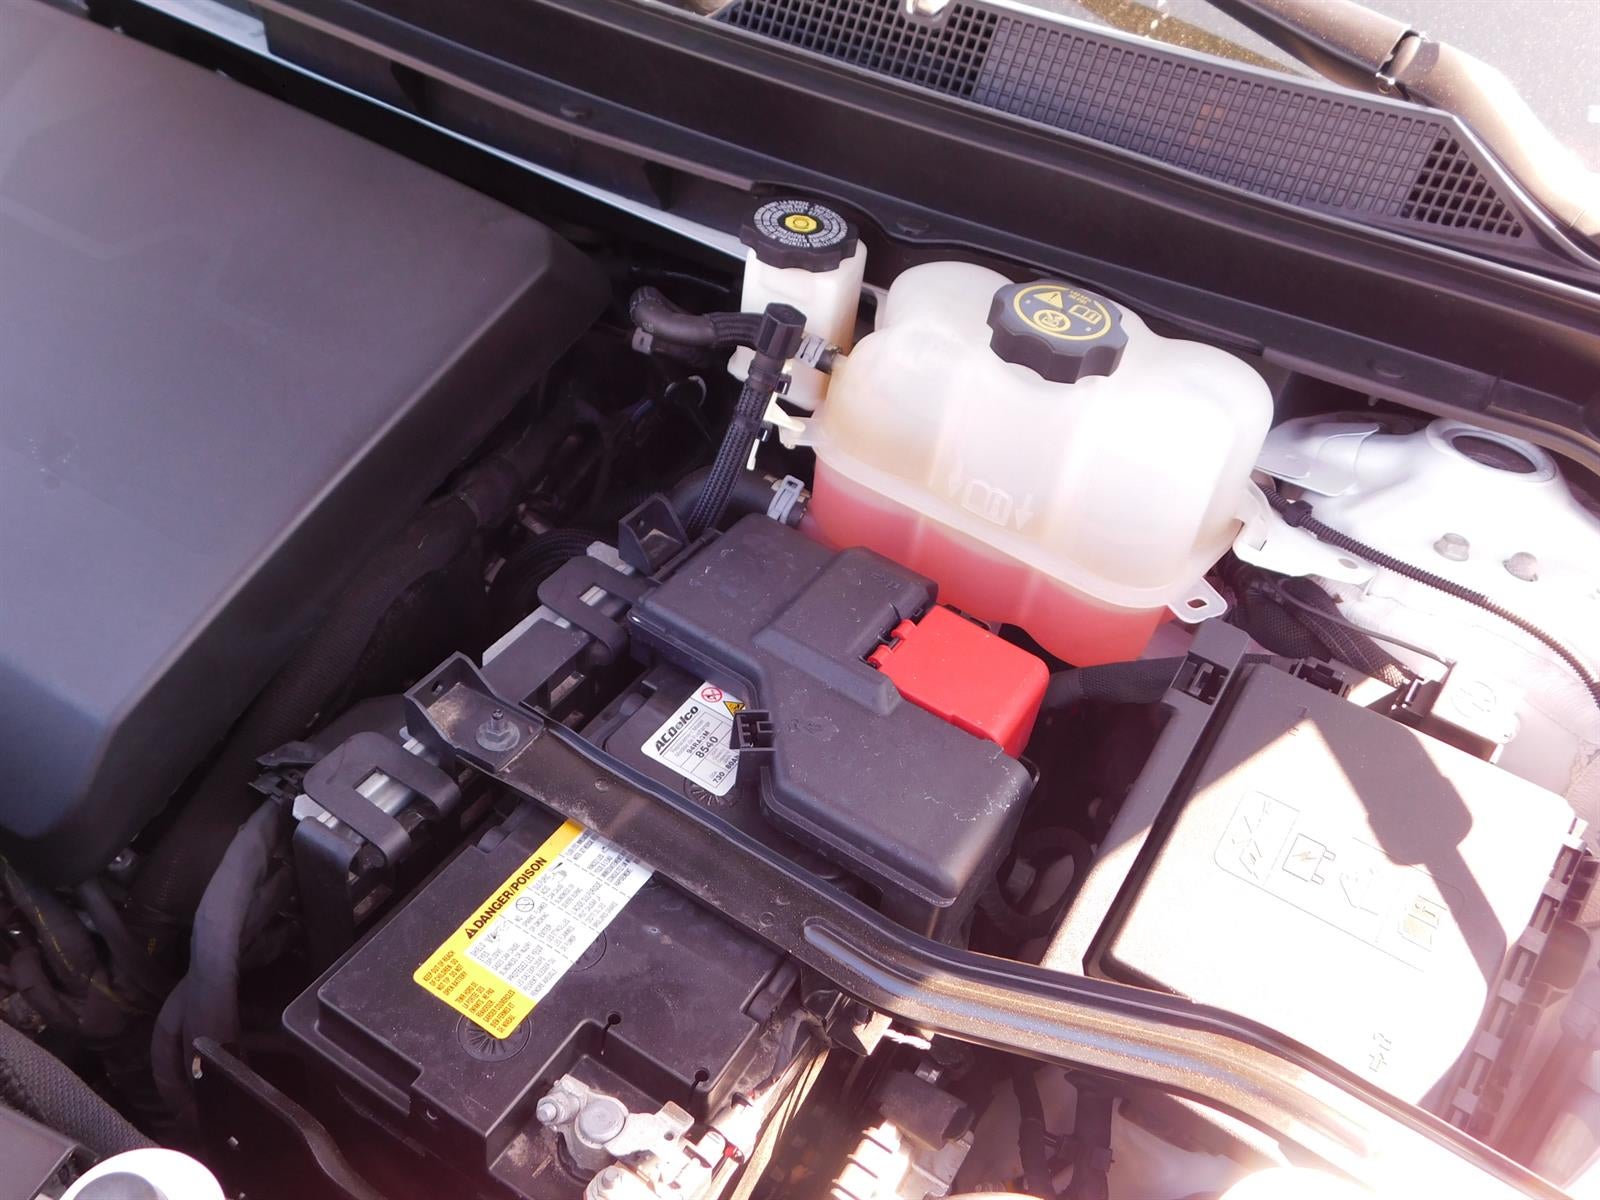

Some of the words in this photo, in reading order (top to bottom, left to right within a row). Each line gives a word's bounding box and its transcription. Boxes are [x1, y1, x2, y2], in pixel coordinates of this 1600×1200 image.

[655, 706, 699, 751] ACDelco
[695, 736, 719, 759] 8540
[472, 856, 547, 929] DANGER/POISON
[423, 971, 432, 981] KEEP
[430, 964, 440, 974] OUT
[441, 950, 454, 962] REACH
[436, 982, 444, 990] NOT
[454, 963, 462, 972] NOT
[443, 985, 454, 995] OPEN
